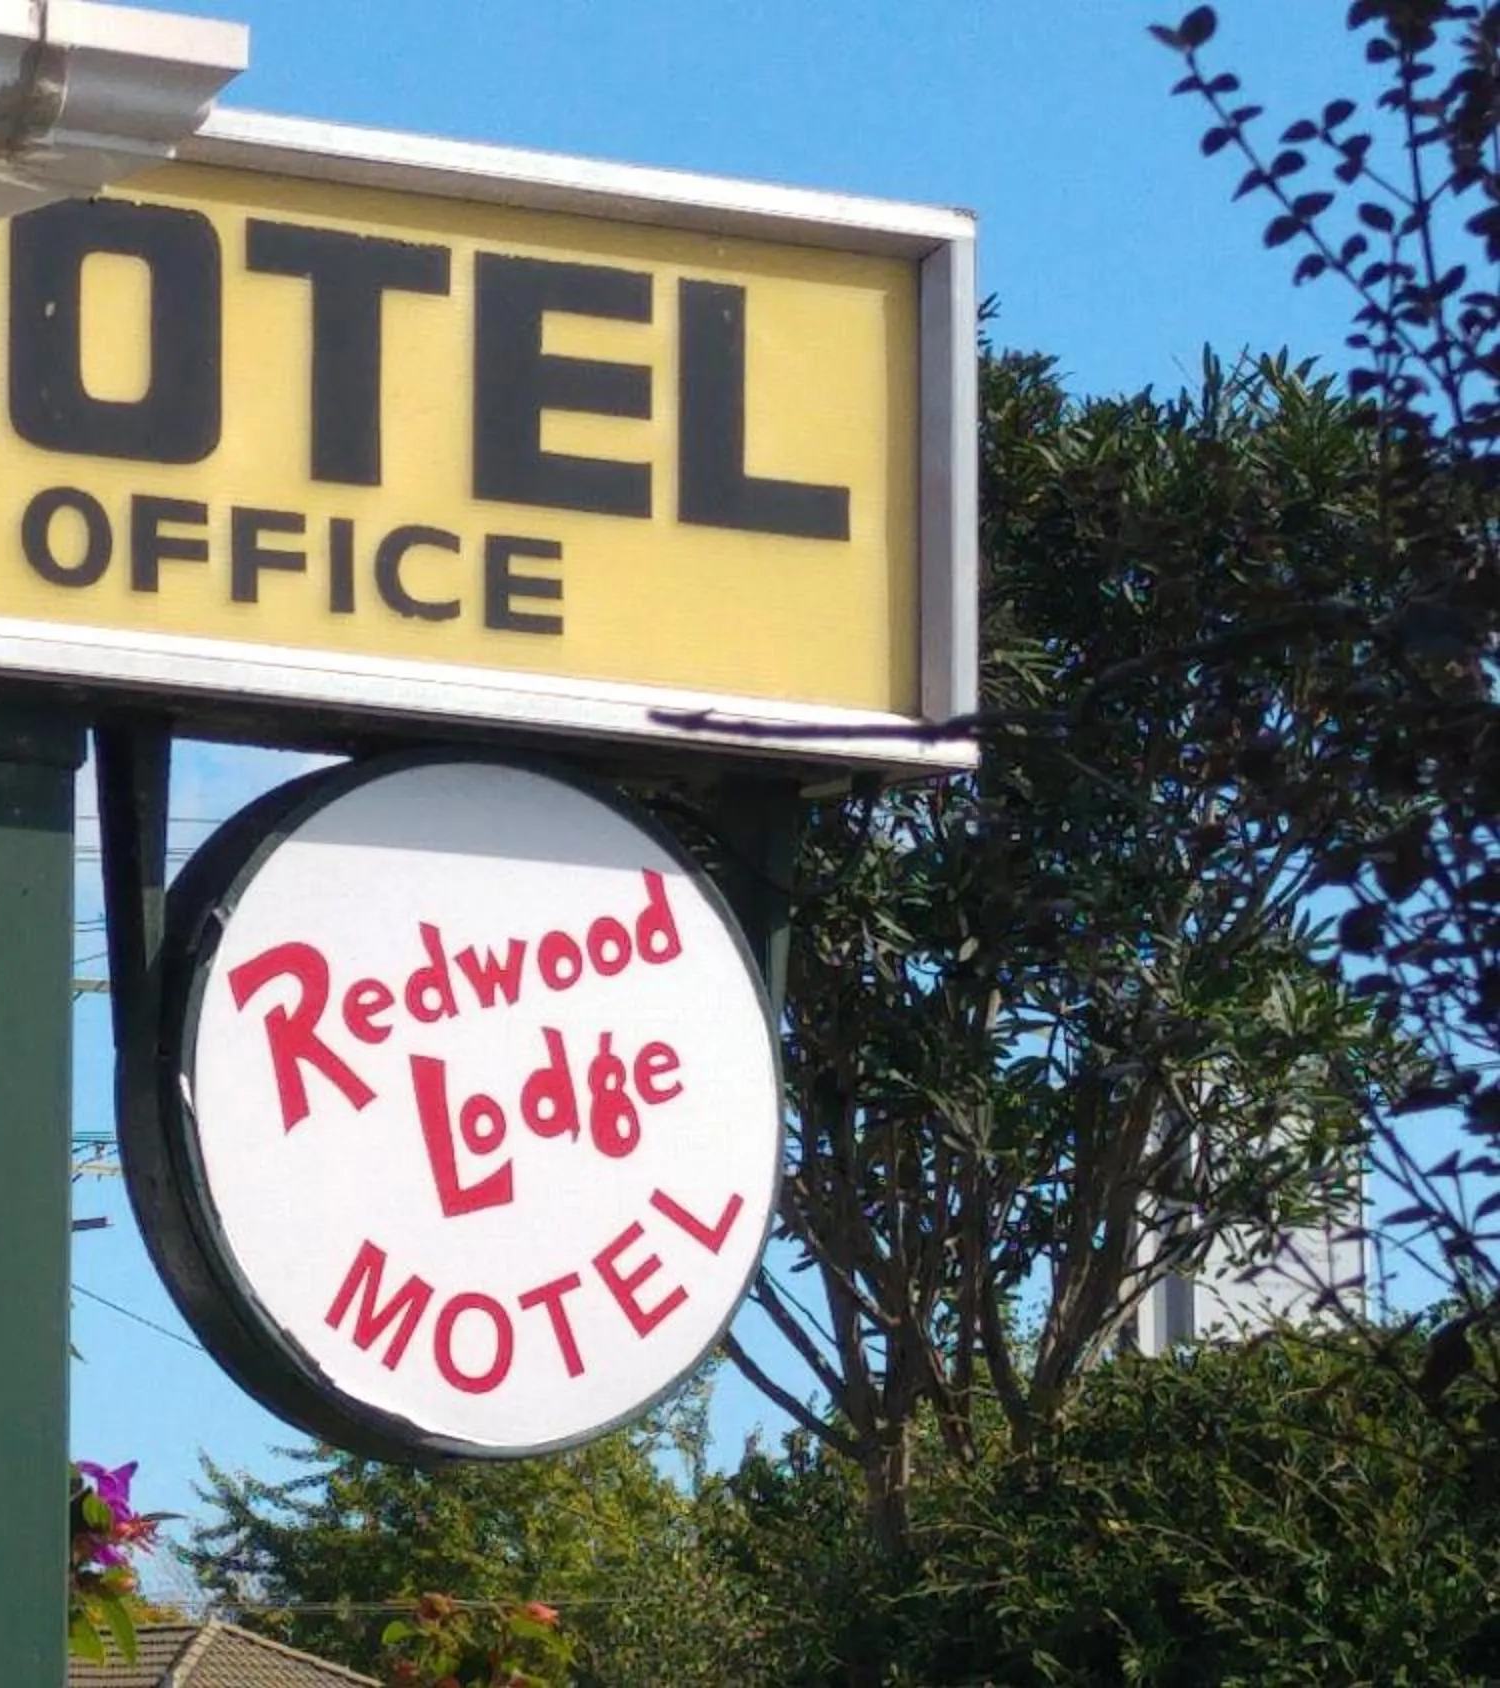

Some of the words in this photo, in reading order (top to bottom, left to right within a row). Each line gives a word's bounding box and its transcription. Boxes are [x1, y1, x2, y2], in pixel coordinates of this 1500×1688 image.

[20, 485, 564, 637] OFFICE
[227, 866, 682, 1135] Redwood
[408, 1026, 684, 1218] Lodge
[323, 1186, 745, 1395] MOTEL
